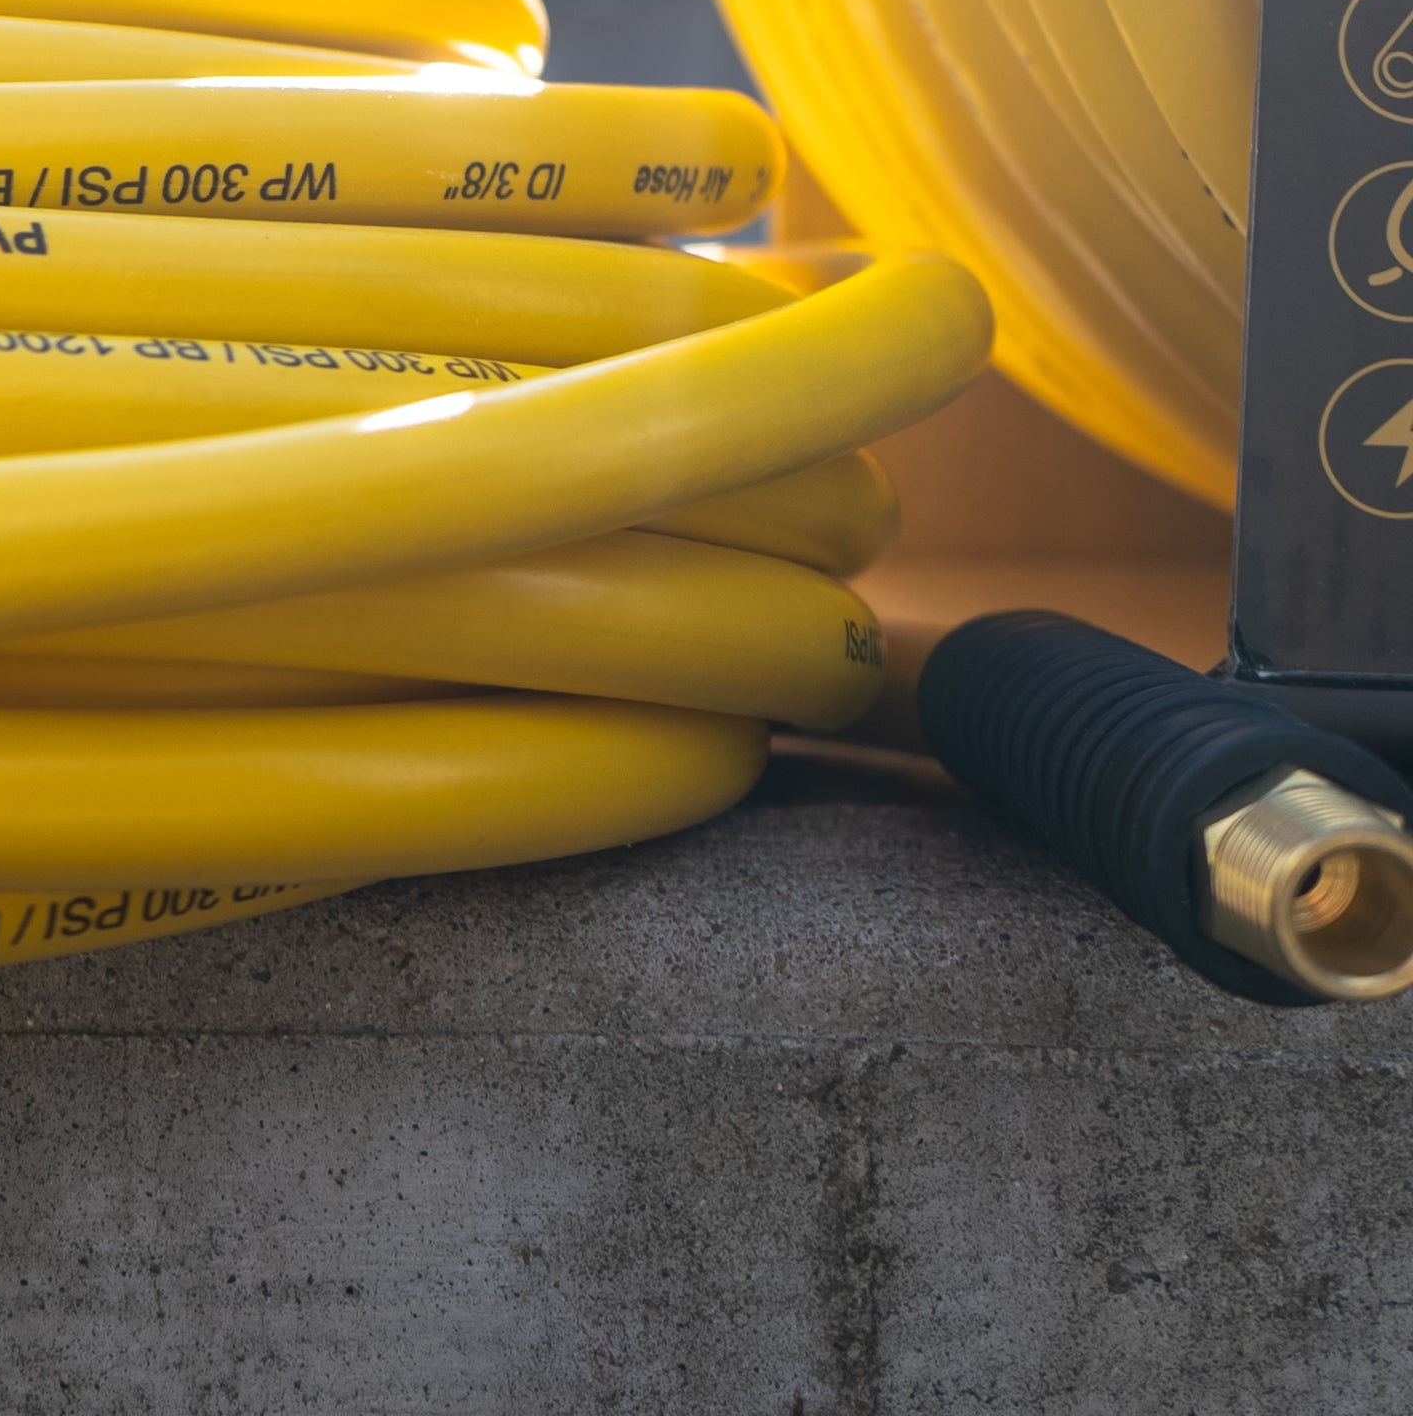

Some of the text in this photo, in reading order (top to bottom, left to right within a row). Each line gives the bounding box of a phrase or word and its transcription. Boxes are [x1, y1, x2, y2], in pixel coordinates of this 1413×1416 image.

[28, 166, 50, 208] /
[60, 165, 149, 206] PSI
[161, 162, 250, 204] 300
[259, 162, 338, 201] WP
[443, 161, 520, 201] 3/8"
[526, 163, 566, 201] ID
[633, 164, 699, 203] Hose
[245, 343, 340, 370] PSI
[343, 348, 435, 375] 300
[445, 357, 522, 383] WP
[11, 904, 35, 947] /
[43, 890, 129, 940] PSI
